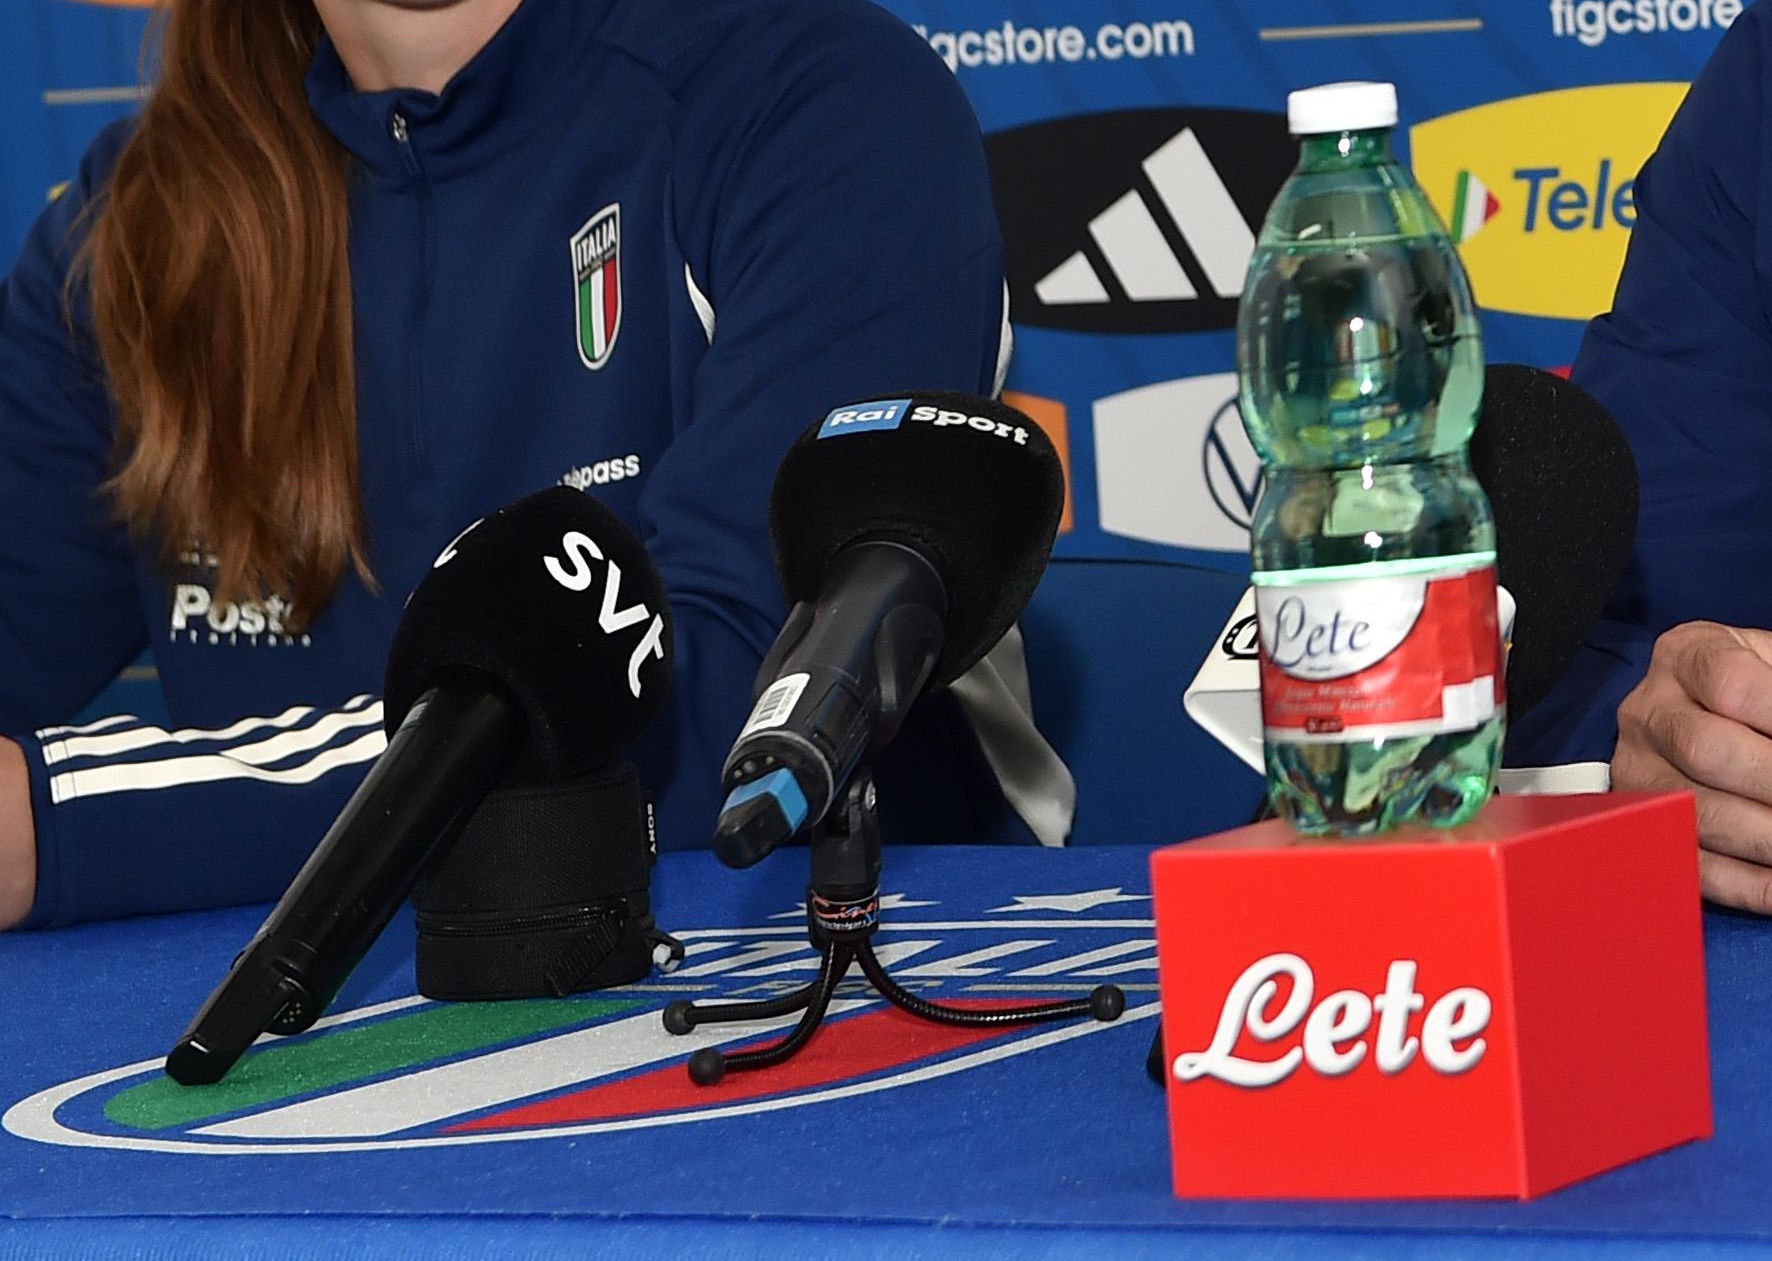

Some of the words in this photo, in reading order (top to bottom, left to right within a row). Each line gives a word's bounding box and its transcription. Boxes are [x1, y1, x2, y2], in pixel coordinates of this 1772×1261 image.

[912, 20, 1195, 73] gcstore.com
[1514, 157, 1636, 232] Tele
[578, 217, 616, 272] ITALIA
[829, 405, 899, 427] Rai
[171, 584, 292, 634] Post
[1271, 595, 1370, 668] Lete
[1174, 954, 1490, 1085] Lete
